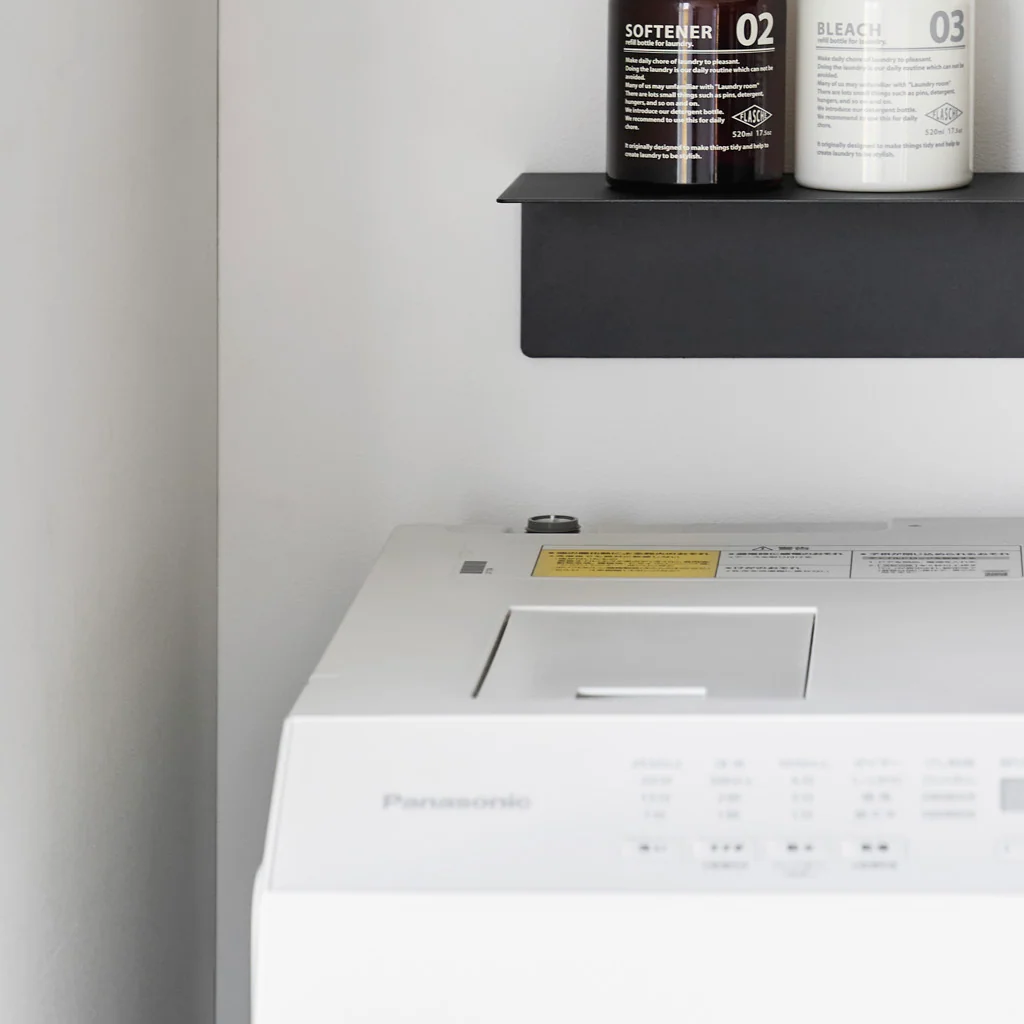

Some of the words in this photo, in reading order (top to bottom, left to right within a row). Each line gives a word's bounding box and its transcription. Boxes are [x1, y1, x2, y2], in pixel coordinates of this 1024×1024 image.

[625, 24, 713, 39] SOFTENER
[736, 12, 774, 46] 02
[817, 22, 881, 37] BLEACH
[930, 9, 964, 44] 03
[665, 40, 694, 49] laundry.
[625, 65, 639, 73] Doing
[650, 66, 673, 74] laundry
[732, 130, 753, 138] 520ml
[382, 792, 532, 810] Panasonic
